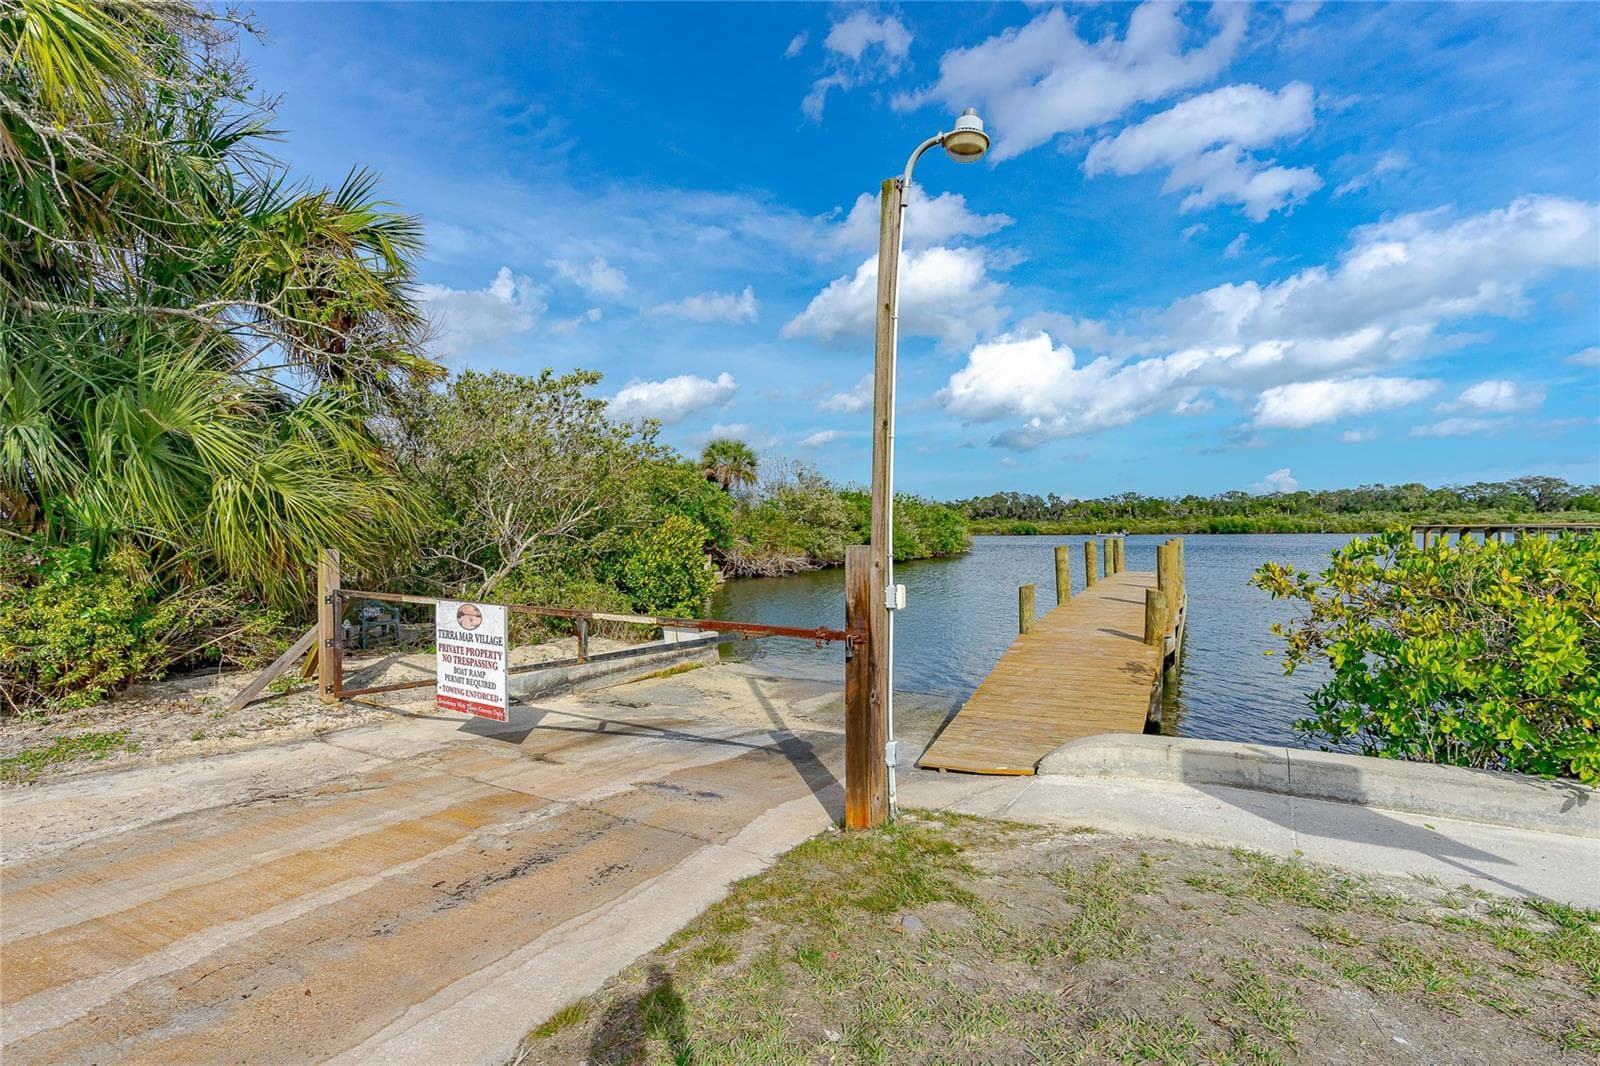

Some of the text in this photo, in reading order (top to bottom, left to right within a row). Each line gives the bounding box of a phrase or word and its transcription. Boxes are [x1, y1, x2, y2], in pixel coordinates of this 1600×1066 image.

[438, 629, 503, 646] TERRA MAR VILLAGE
[438, 643, 503, 661] PRIVATE PROPERTY
[442, 653, 498, 671] NO TRESPASSING
[453, 666, 486, 679] BOAT RAMP
[444, 674, 497, 690] PERMIT REQUIRED
[443, 685, 499, 703] TOWING ENFORCED
